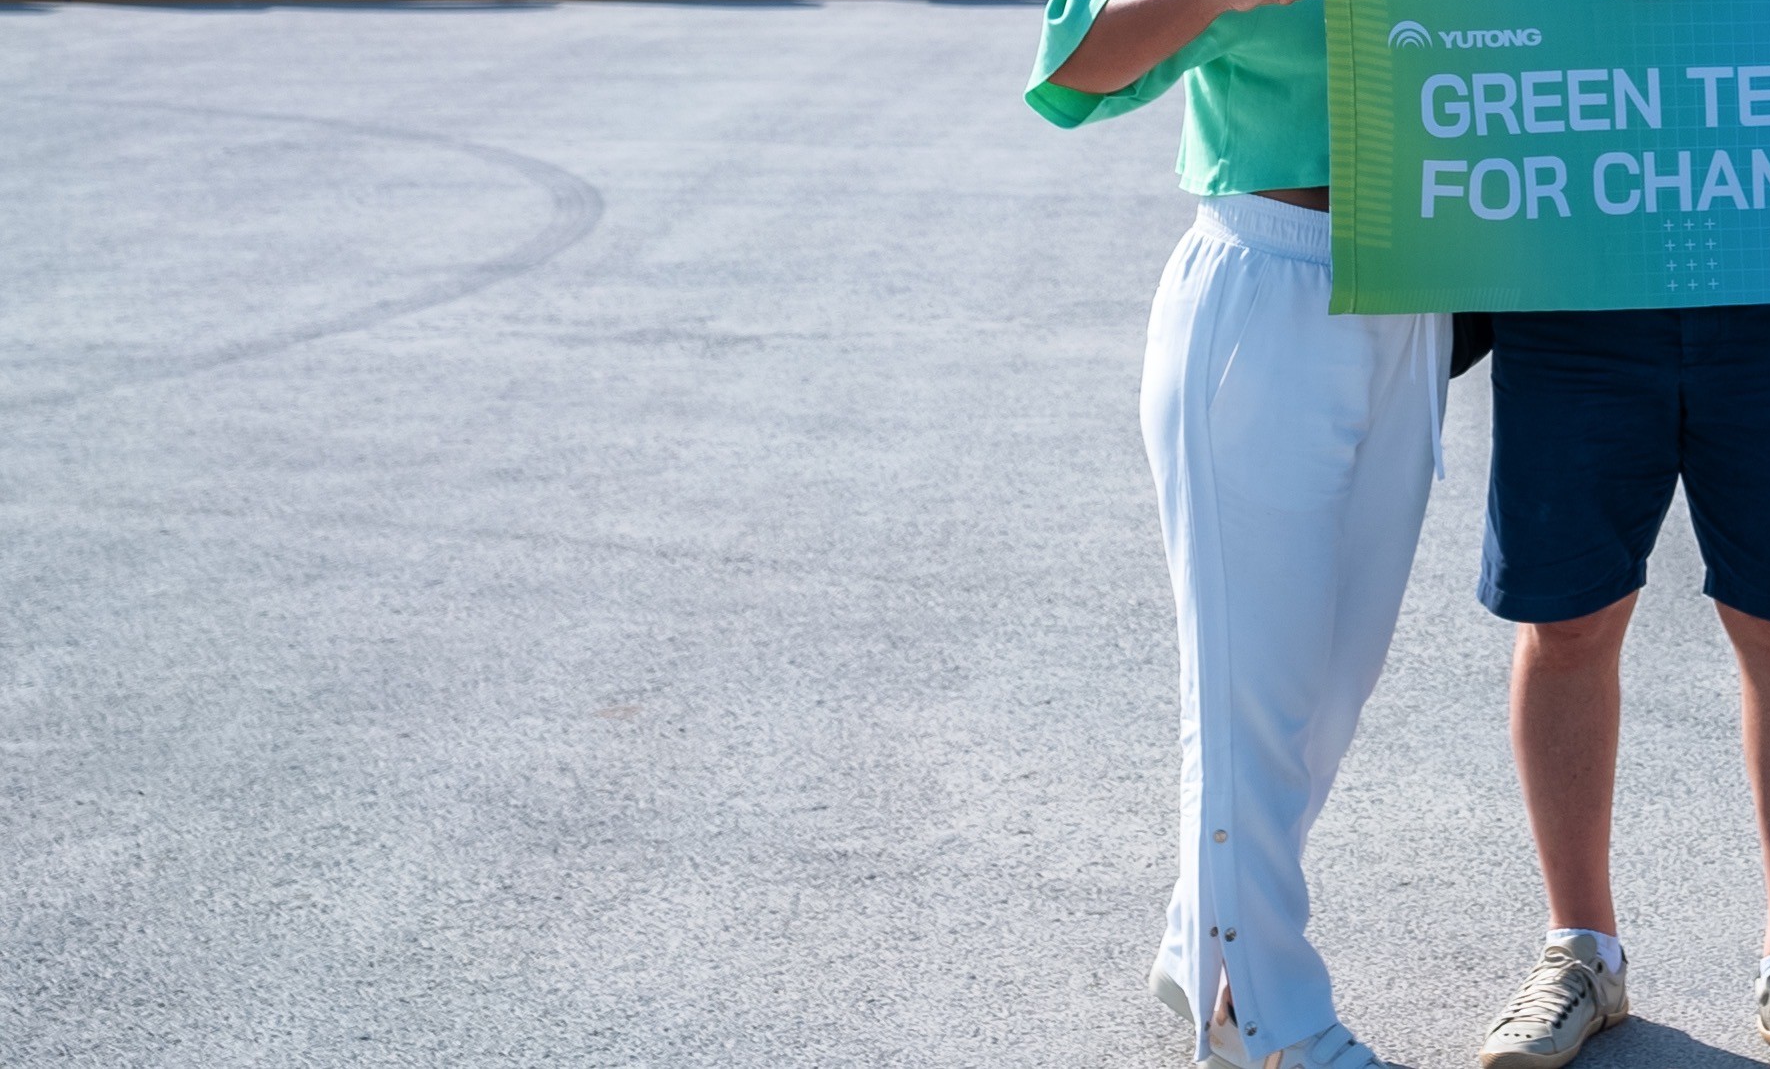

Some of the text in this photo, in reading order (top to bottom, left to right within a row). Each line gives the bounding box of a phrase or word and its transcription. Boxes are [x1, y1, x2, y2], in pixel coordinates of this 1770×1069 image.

[1438, 27, 1542, 49] YUTONG
[1420, 67, 1662, 139] GREEN
[1420, 155, 1571, 221] FOR
